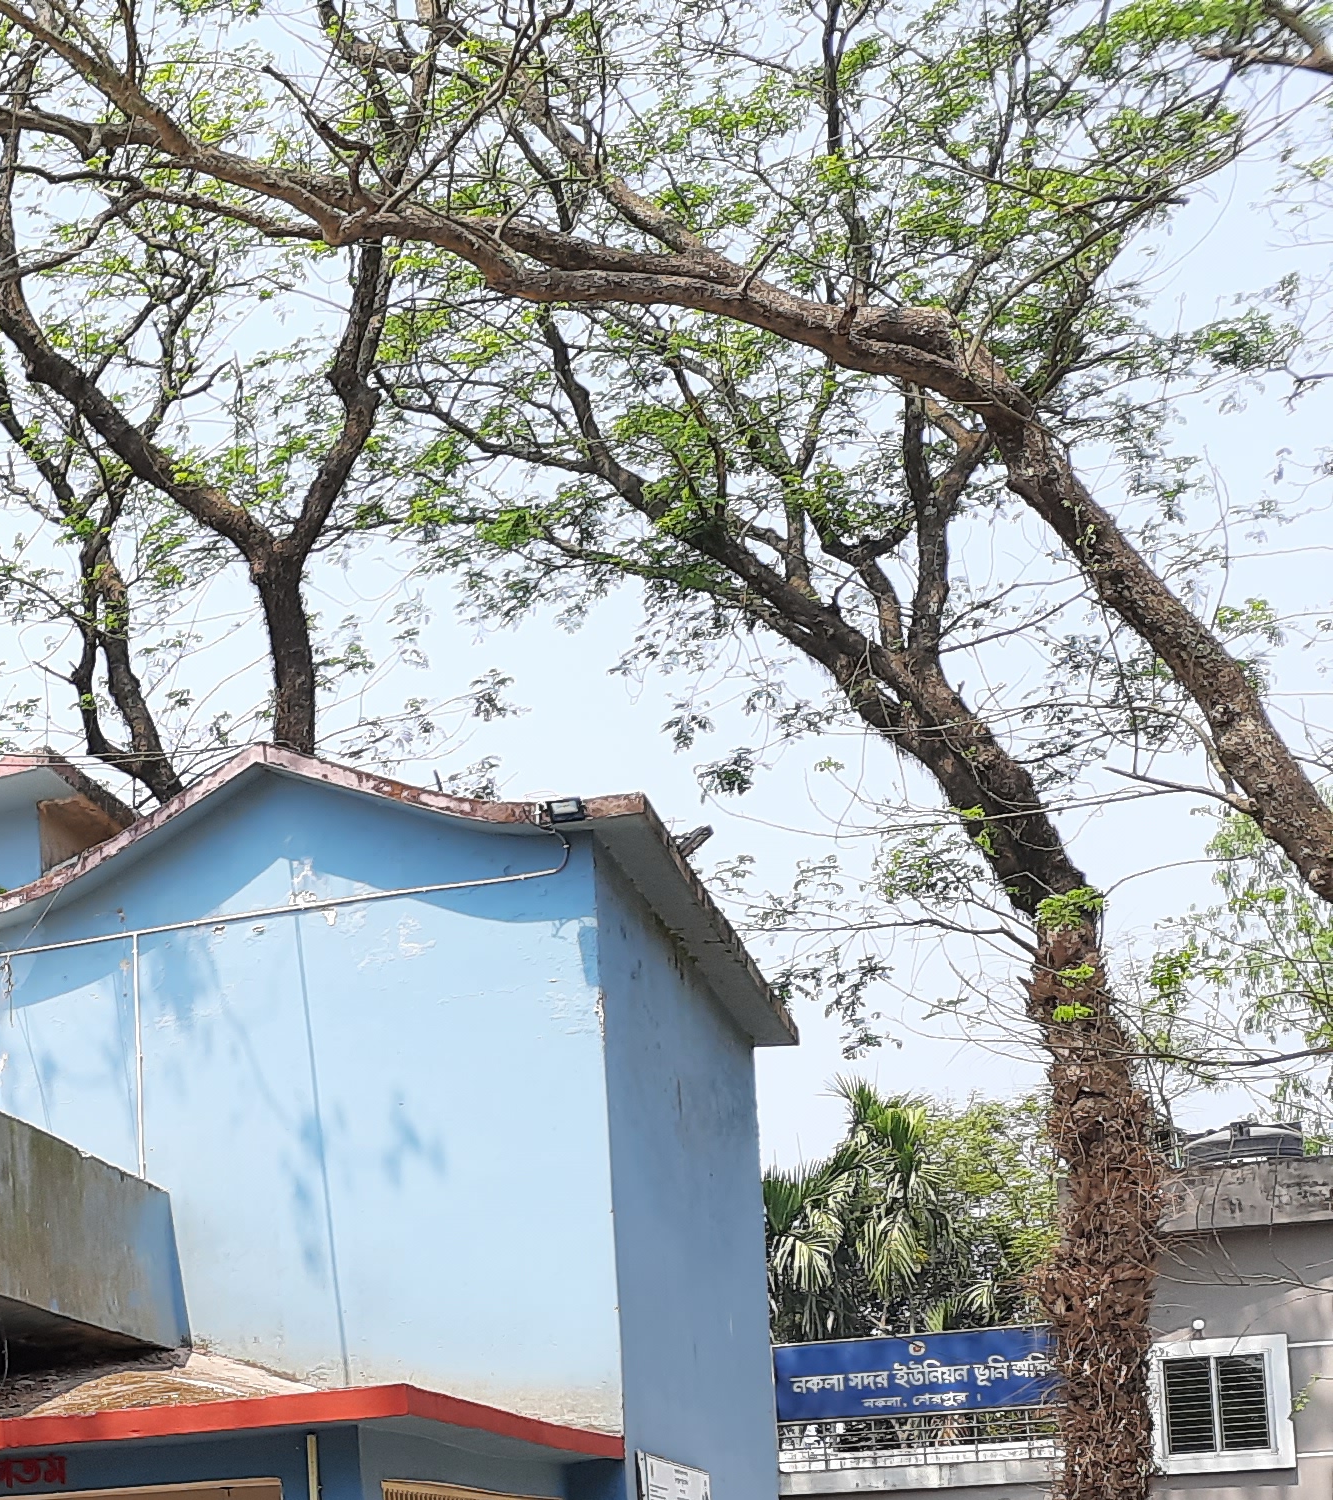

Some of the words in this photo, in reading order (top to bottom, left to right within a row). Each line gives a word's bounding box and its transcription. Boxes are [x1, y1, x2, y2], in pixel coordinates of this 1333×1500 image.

[789, 1373, 845, 1395] নকলা
[849, 1370, 889, 1391] সদর
[893, 1359, 970, 1389] ইউনিয়ন
